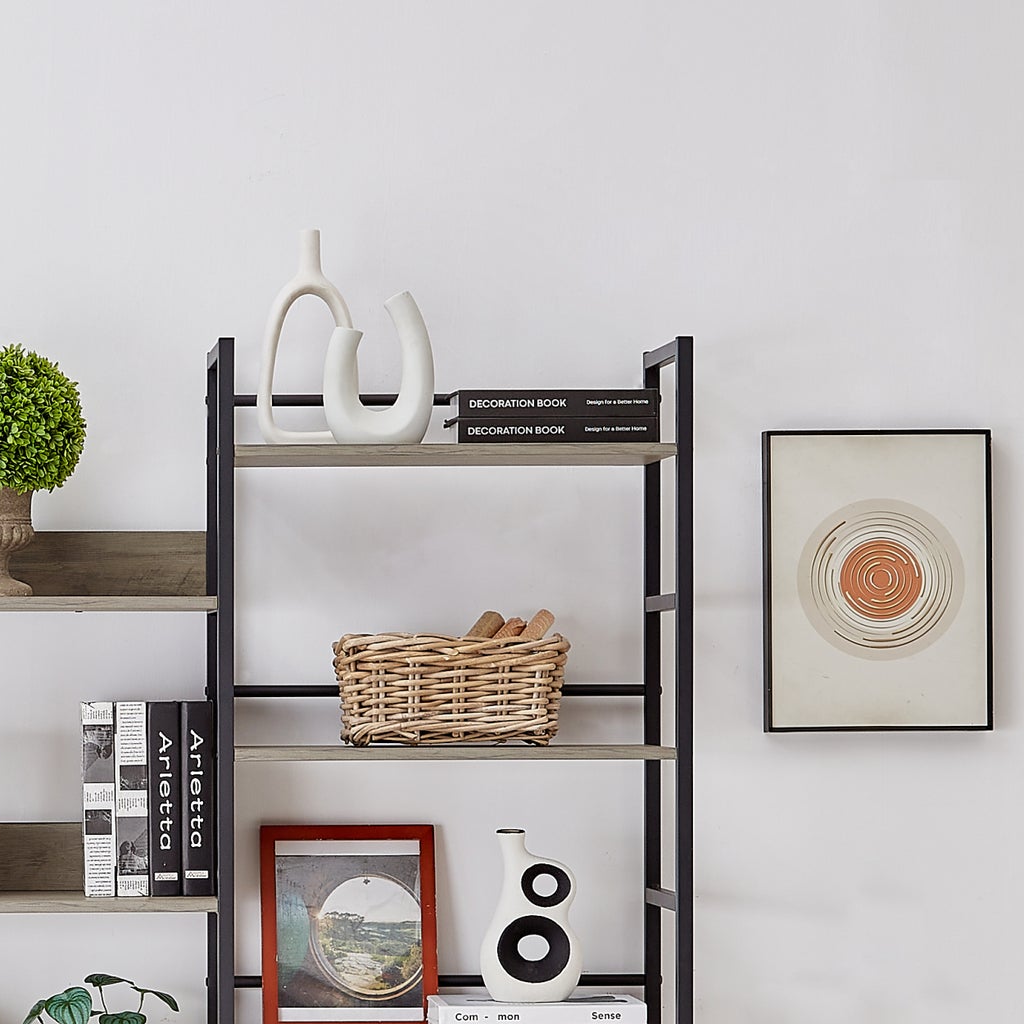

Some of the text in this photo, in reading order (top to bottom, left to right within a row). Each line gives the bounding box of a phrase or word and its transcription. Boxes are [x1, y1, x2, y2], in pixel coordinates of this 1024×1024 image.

[469, 398, 567, 409] DECORATION BOOK
[467, 426, 565, 436] DECORATION BOOK
[158, 731, 173, 850] Arletta
[190, 729, 204, 848] Arletta
[455, 1012, 479, 1021] Com
[591, 1011, 622, 1020] Sense
